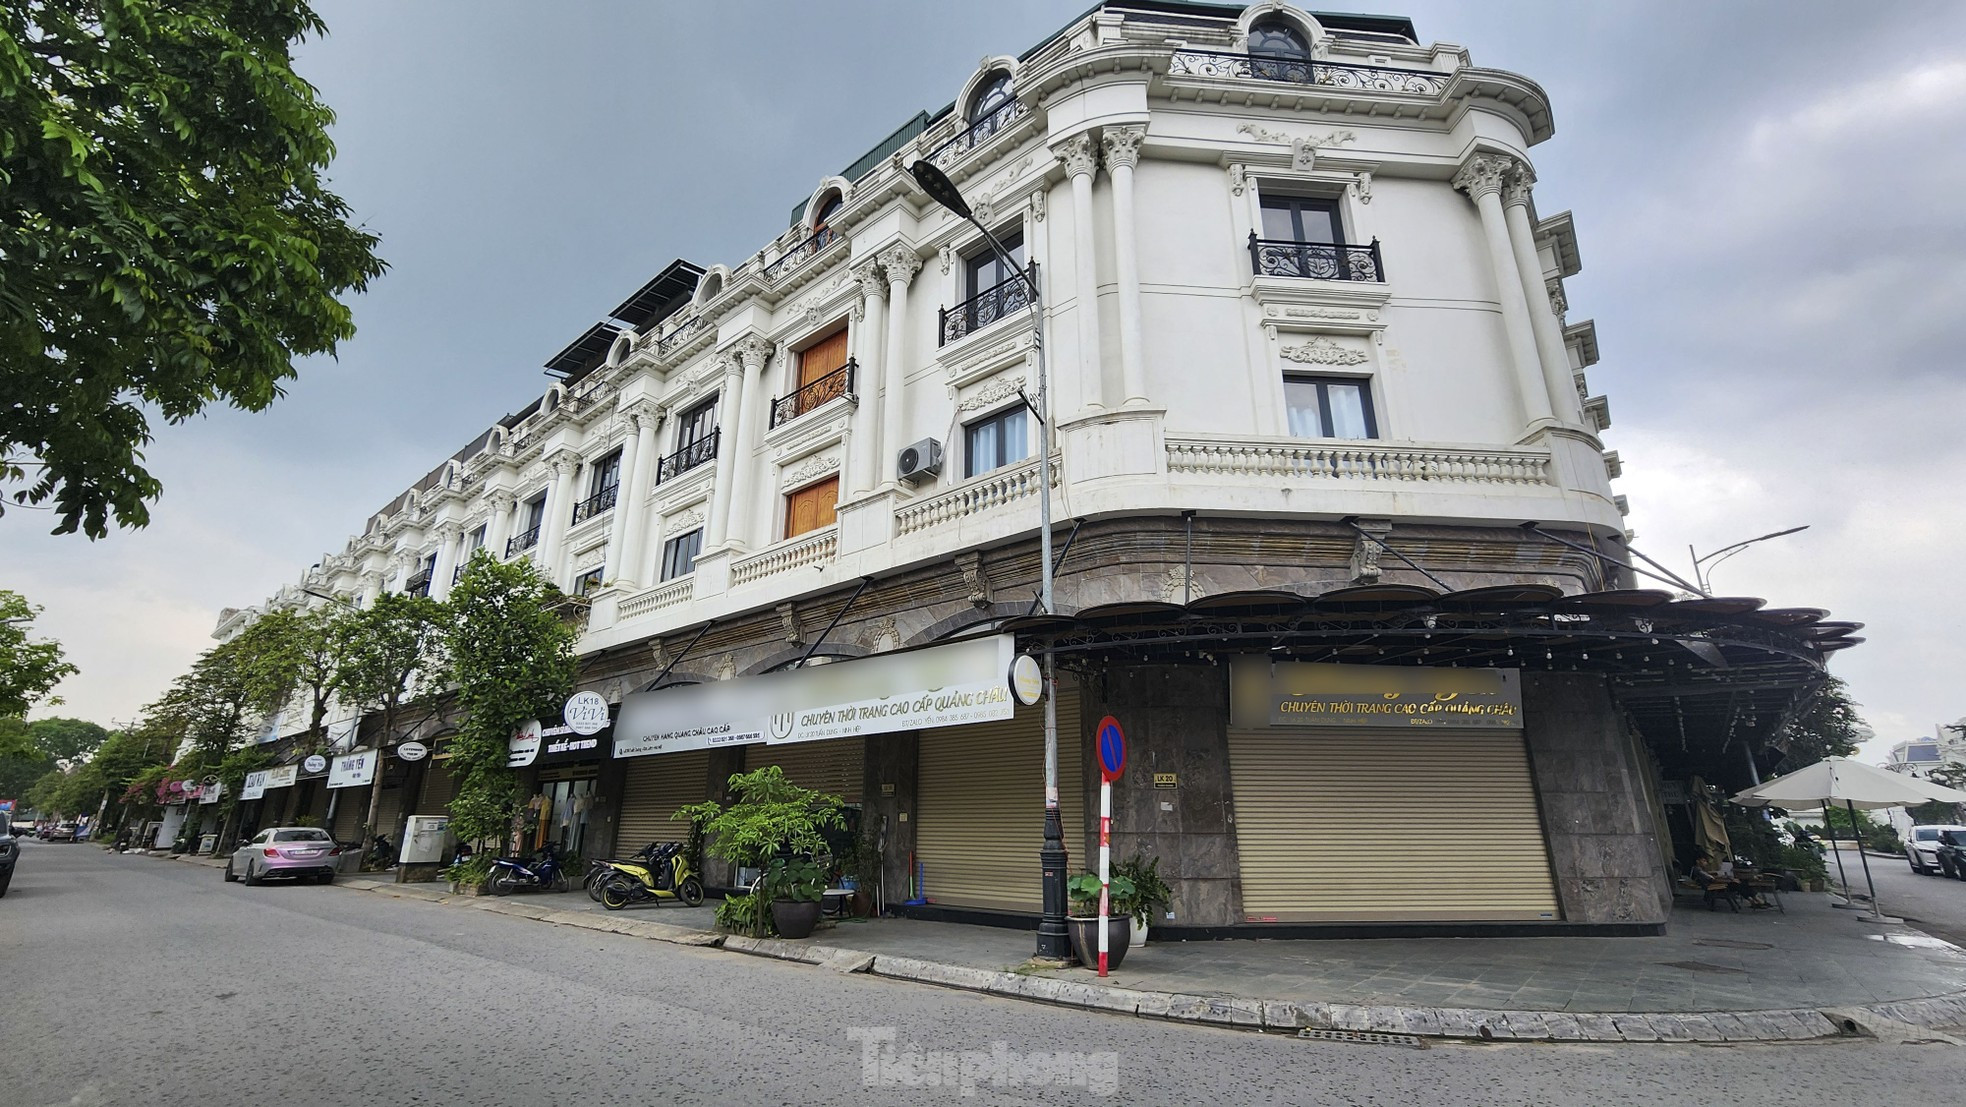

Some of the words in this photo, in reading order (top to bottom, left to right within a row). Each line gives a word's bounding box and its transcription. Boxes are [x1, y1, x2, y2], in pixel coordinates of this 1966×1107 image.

[578, 696, 599, 706] LK18
[801, 709, 836, 727] CHUYÊN
[838, 705, 857, 723] THỜI
[859, 704, 889, 719] TRANG
[890, 700, 909, 715] CAO
[912, 694, 933, 713] CẤP
[934, 690, 973, 713] QUẢNG
[1280, 699, 1326, 713] CHUYÊN
[1329, 699, 1354, 714] THỜI
[1356, 702, 1392, 714] TRANG
[1394, 703, 1417, 714] CAO
